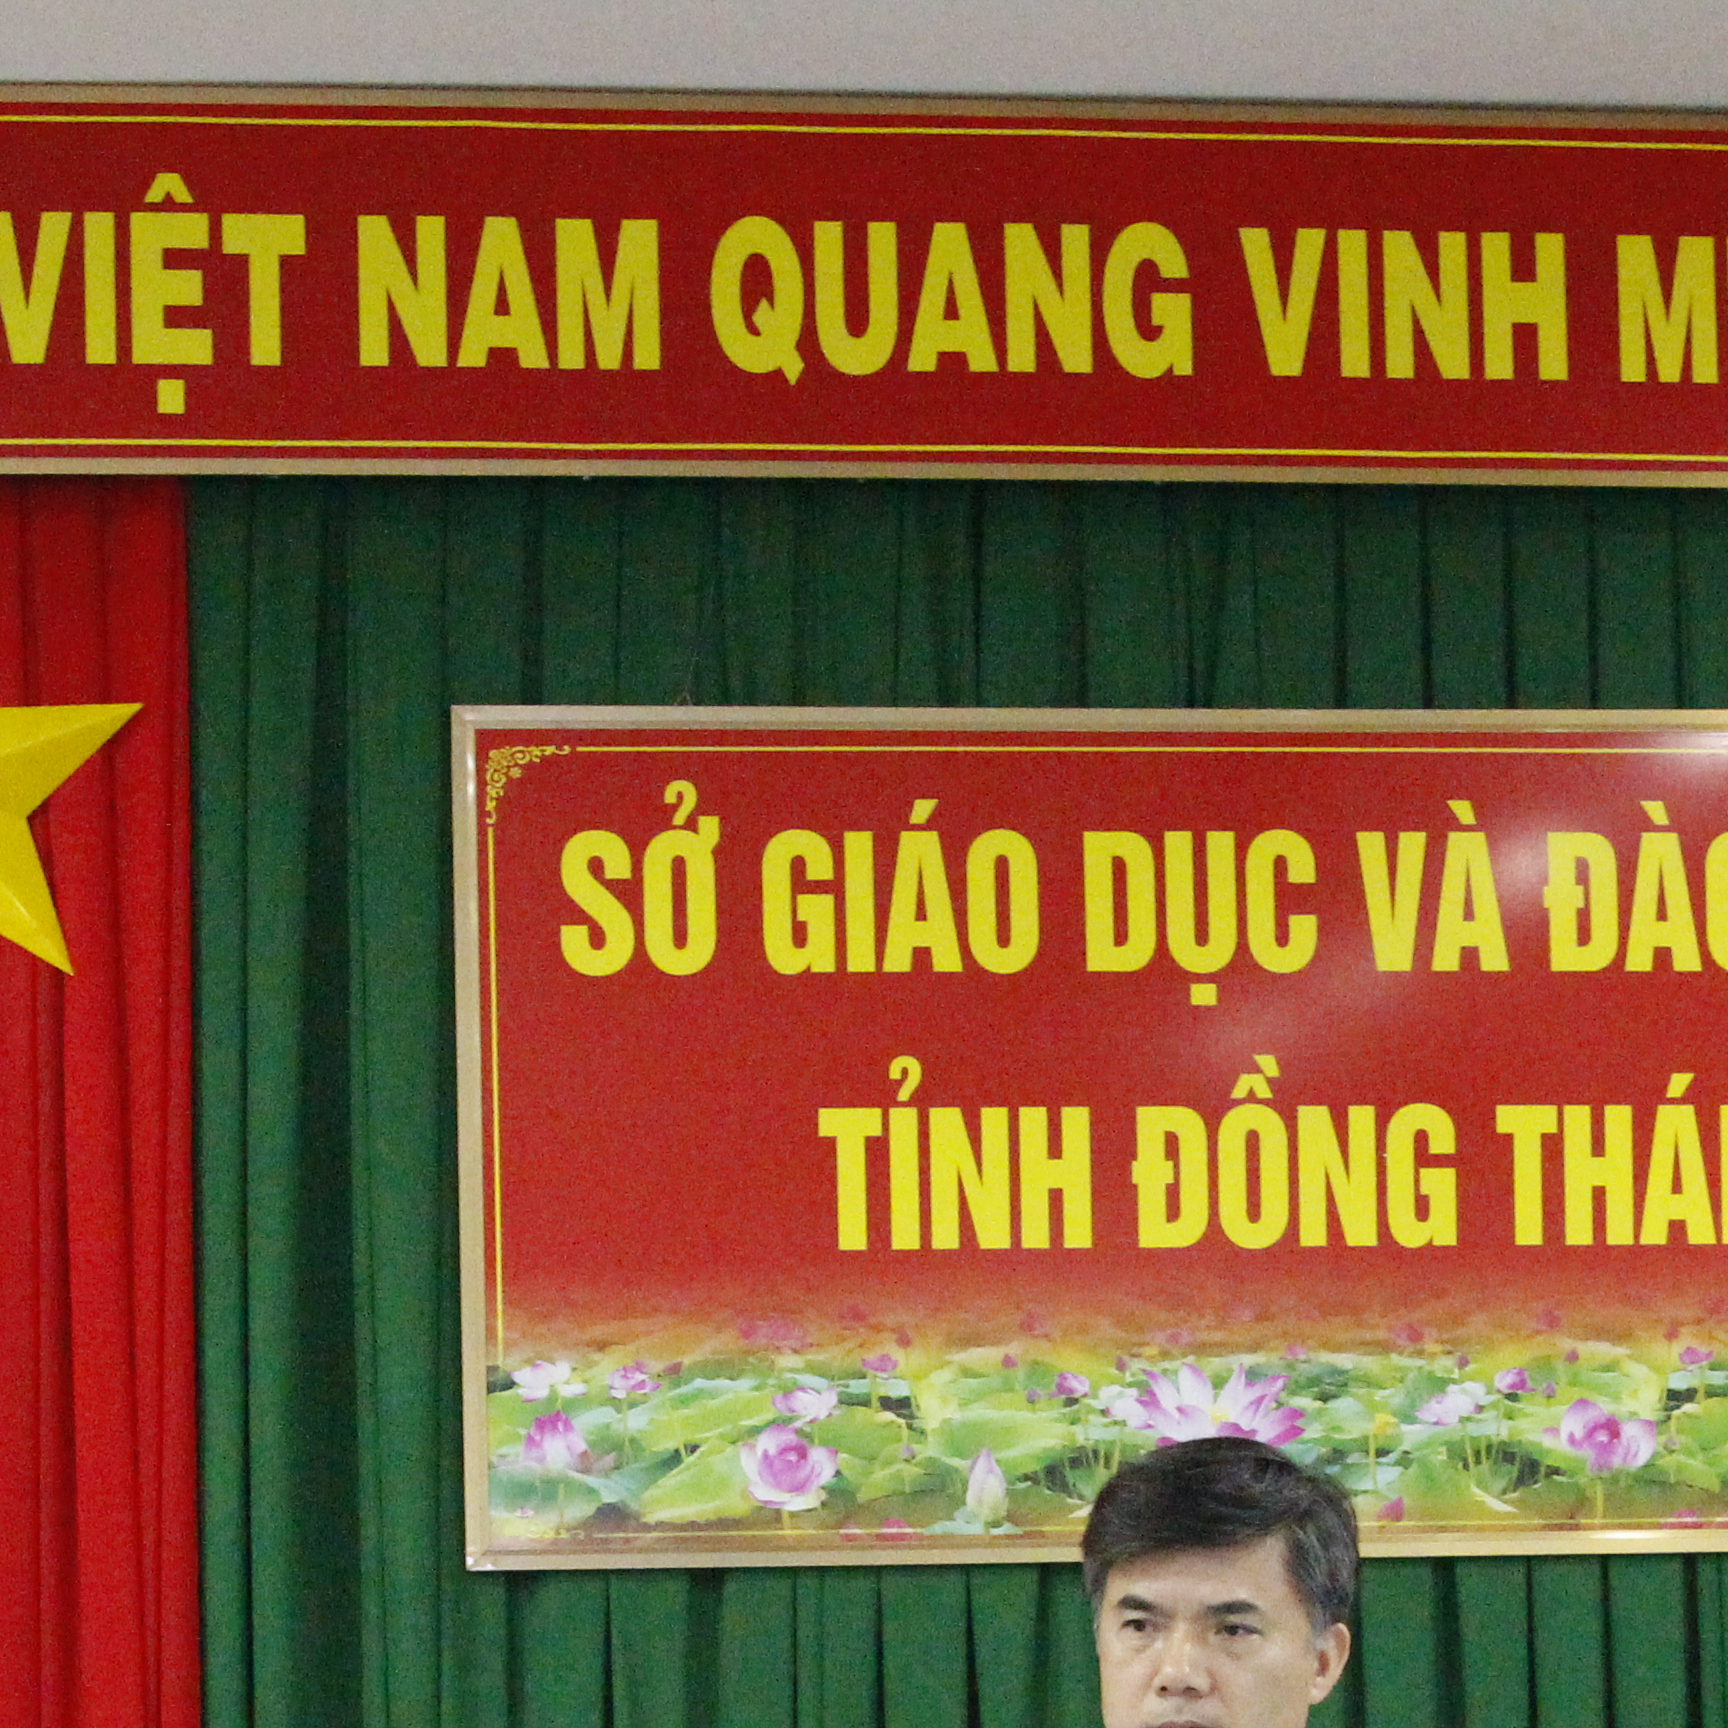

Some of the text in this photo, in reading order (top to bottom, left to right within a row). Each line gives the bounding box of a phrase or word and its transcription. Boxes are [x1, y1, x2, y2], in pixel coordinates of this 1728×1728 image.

[358, 215, 660, 369] NAM
[709, 215, 1193, 384] QUANG
[1238, 226, 1571, 382] VINH
[561, 781, 719, 976] SỞ
[762, 799, 1039, 974] GIÁO
[1084, 830, 1317, 1005] DỤC
[1357, 800, 1509, 971] VÀ
[818, 1056, 1092, 1250] TỈNH
[1132, 1055, 1457, 1249] ĐỒNG
